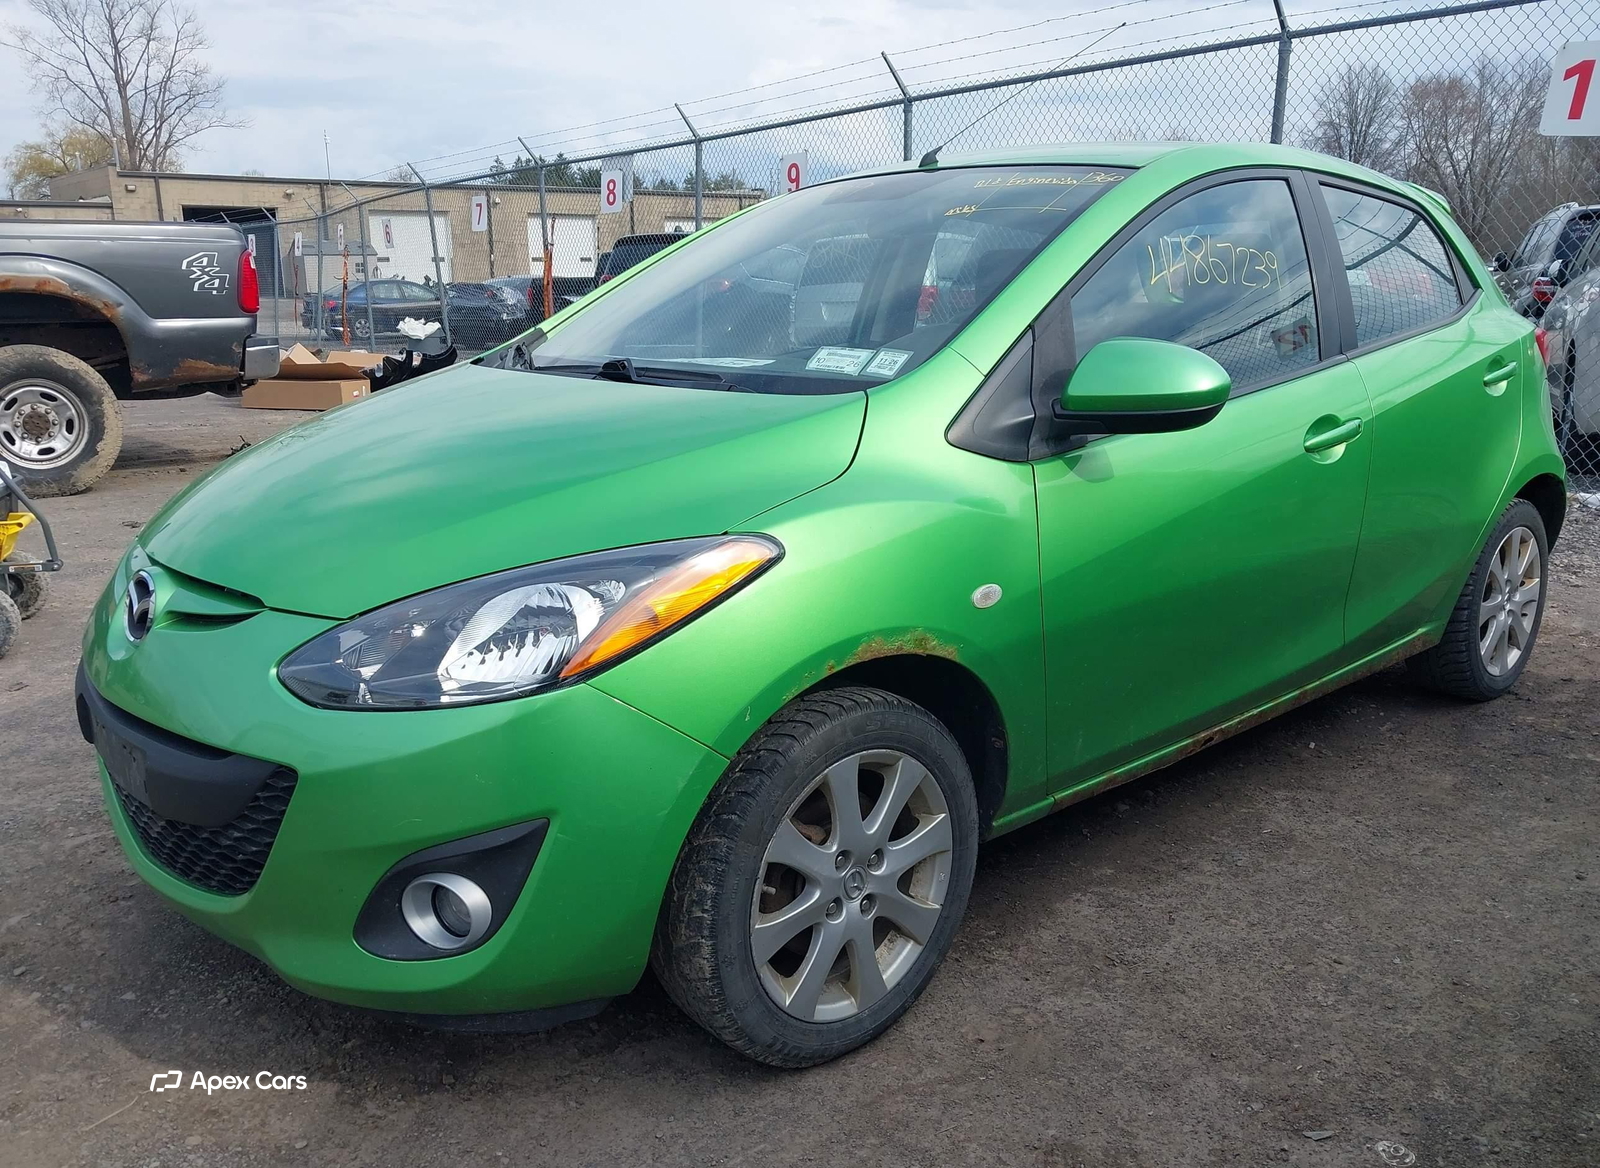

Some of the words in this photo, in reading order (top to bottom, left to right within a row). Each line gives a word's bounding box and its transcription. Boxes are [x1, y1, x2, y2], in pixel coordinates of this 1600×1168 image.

[786, 162, 801, 192] 9
[606, 178, 617, 206] 8
[475, 203, 483, 225] 7
[384, 224, 391, 244] 6
[846, 360, 860, 368] 26
